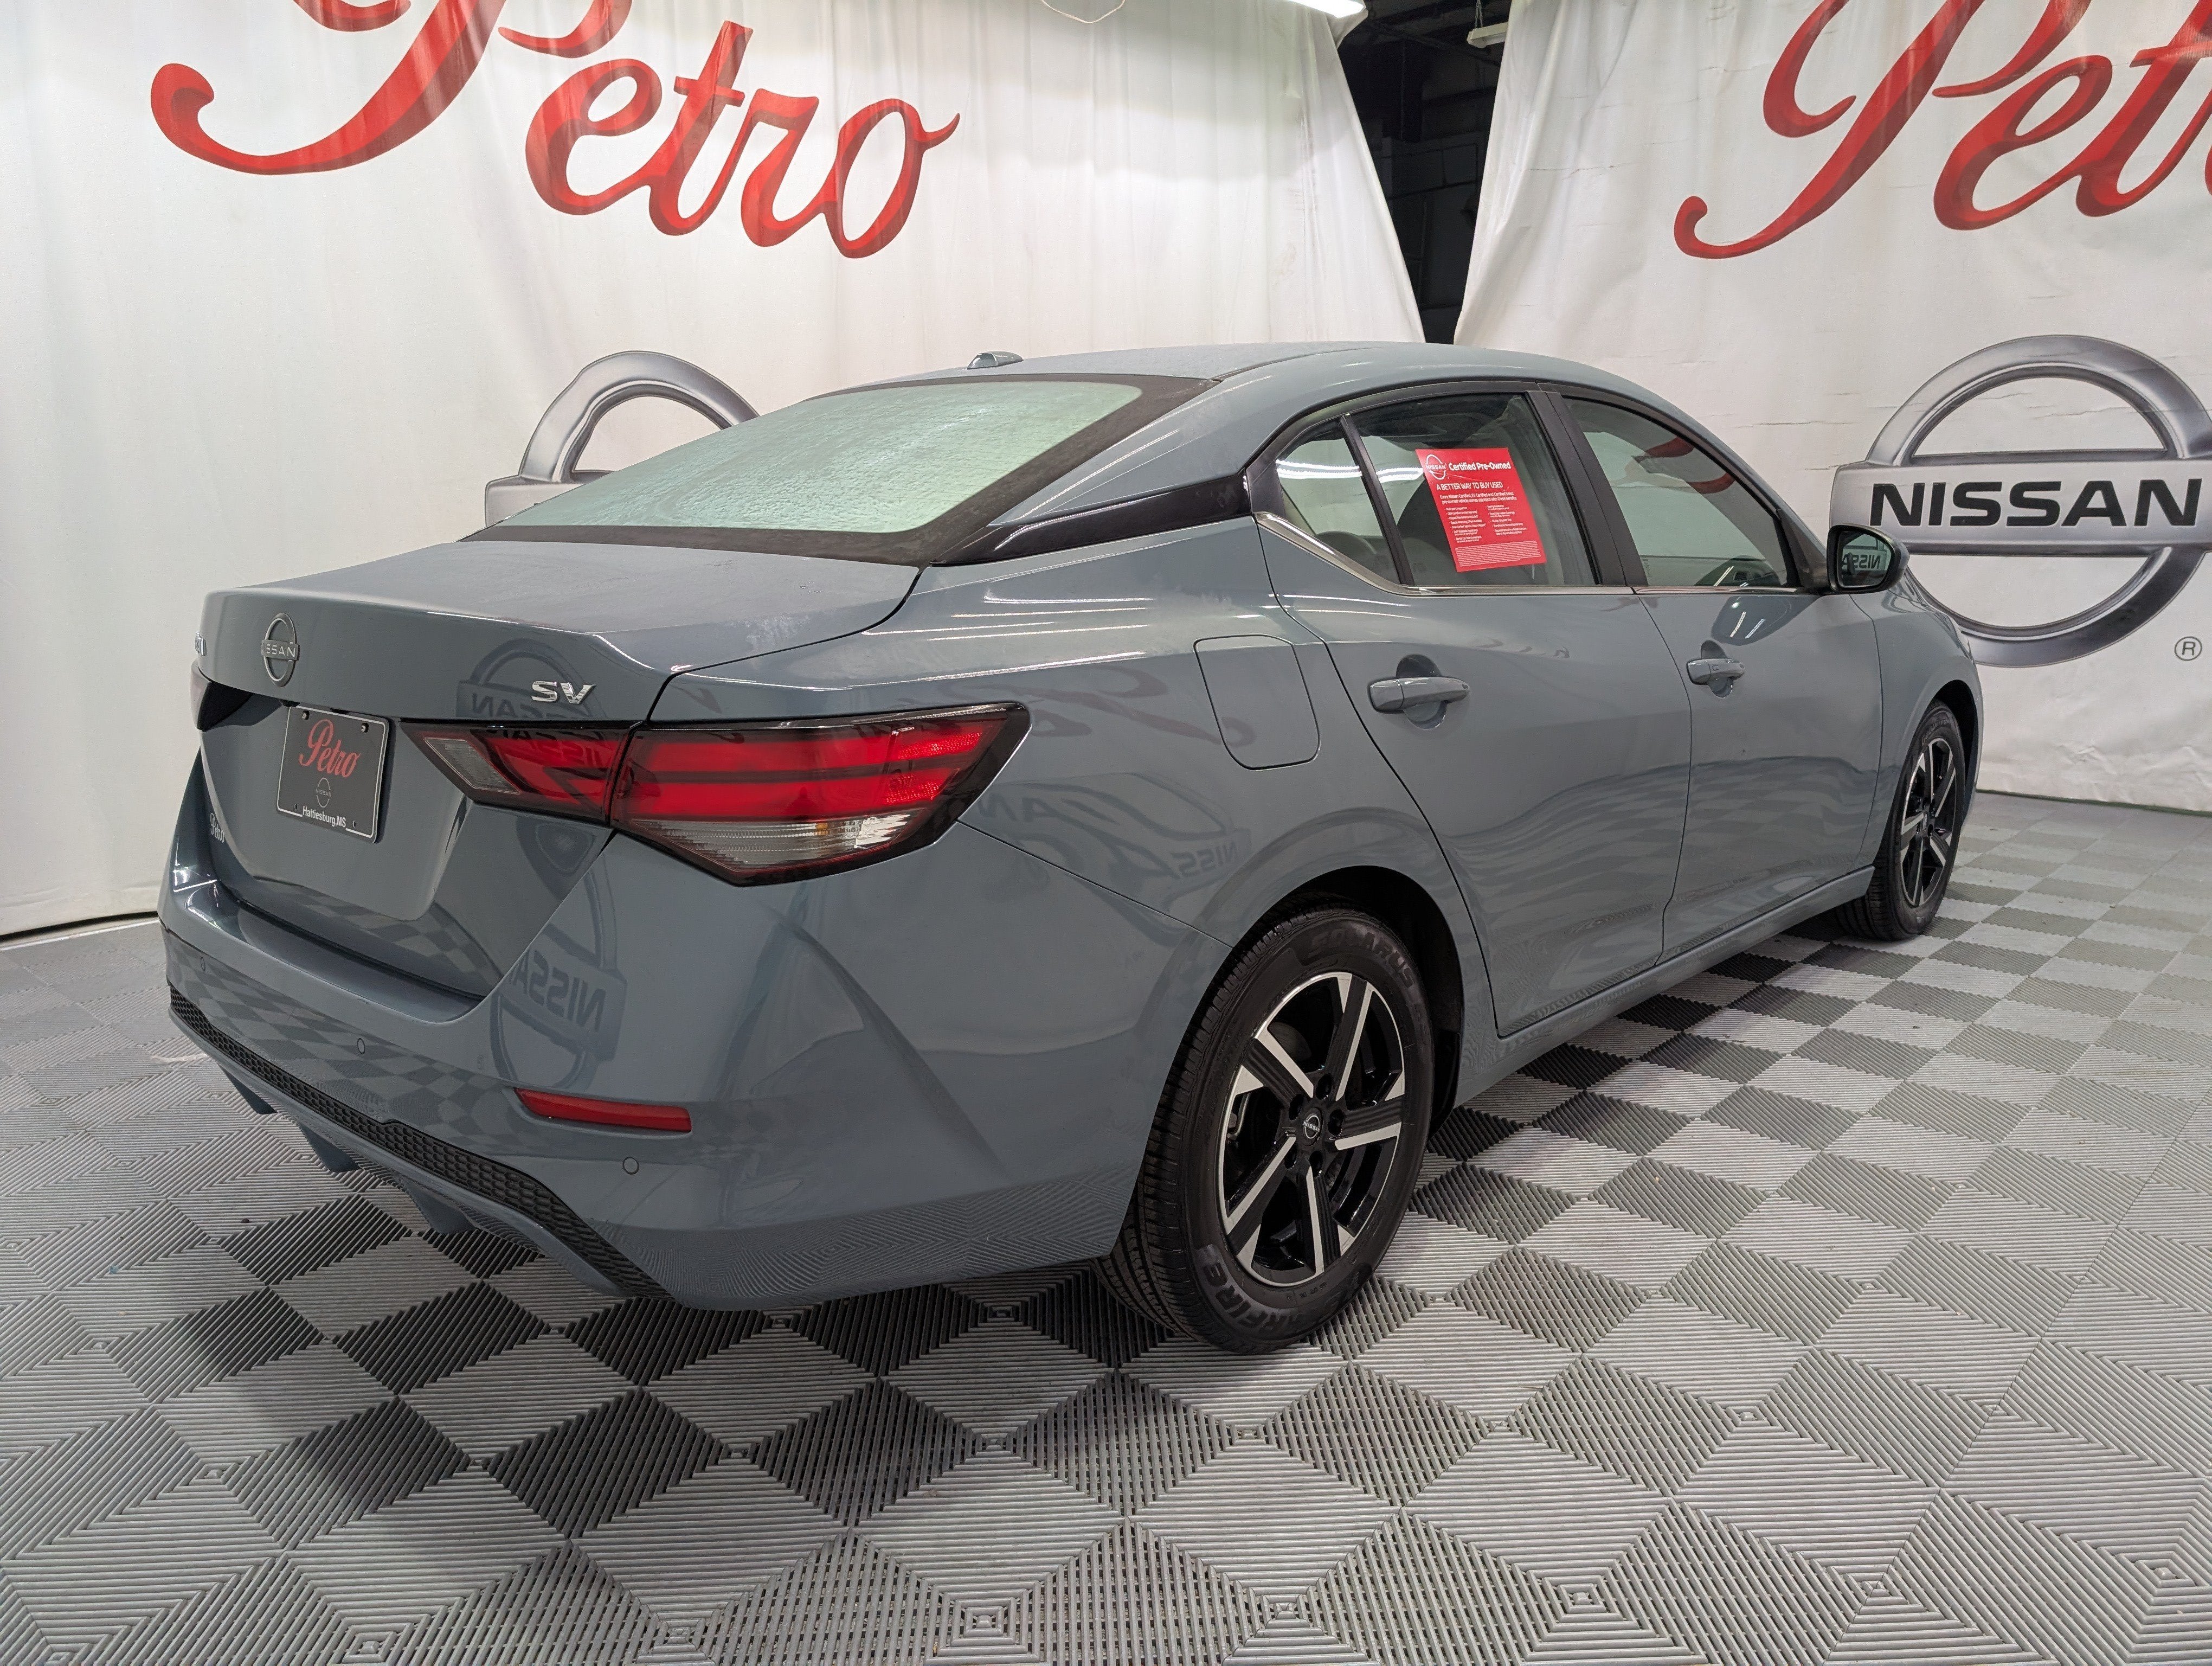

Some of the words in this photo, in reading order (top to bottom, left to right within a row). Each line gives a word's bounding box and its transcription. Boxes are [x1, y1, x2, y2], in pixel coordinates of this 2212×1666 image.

[1448, 461, 1476, 471] Certified
[1477, 461, 1512, 471] Pre-Owned
[1869, 478, 2202, 527] NISSAN
[531, 680, 597, 704] SV
[299, 718, 362, 778] Petro
[316, 788, 332, 797] NISSAN
[210, 812, 225, 843] Petro
